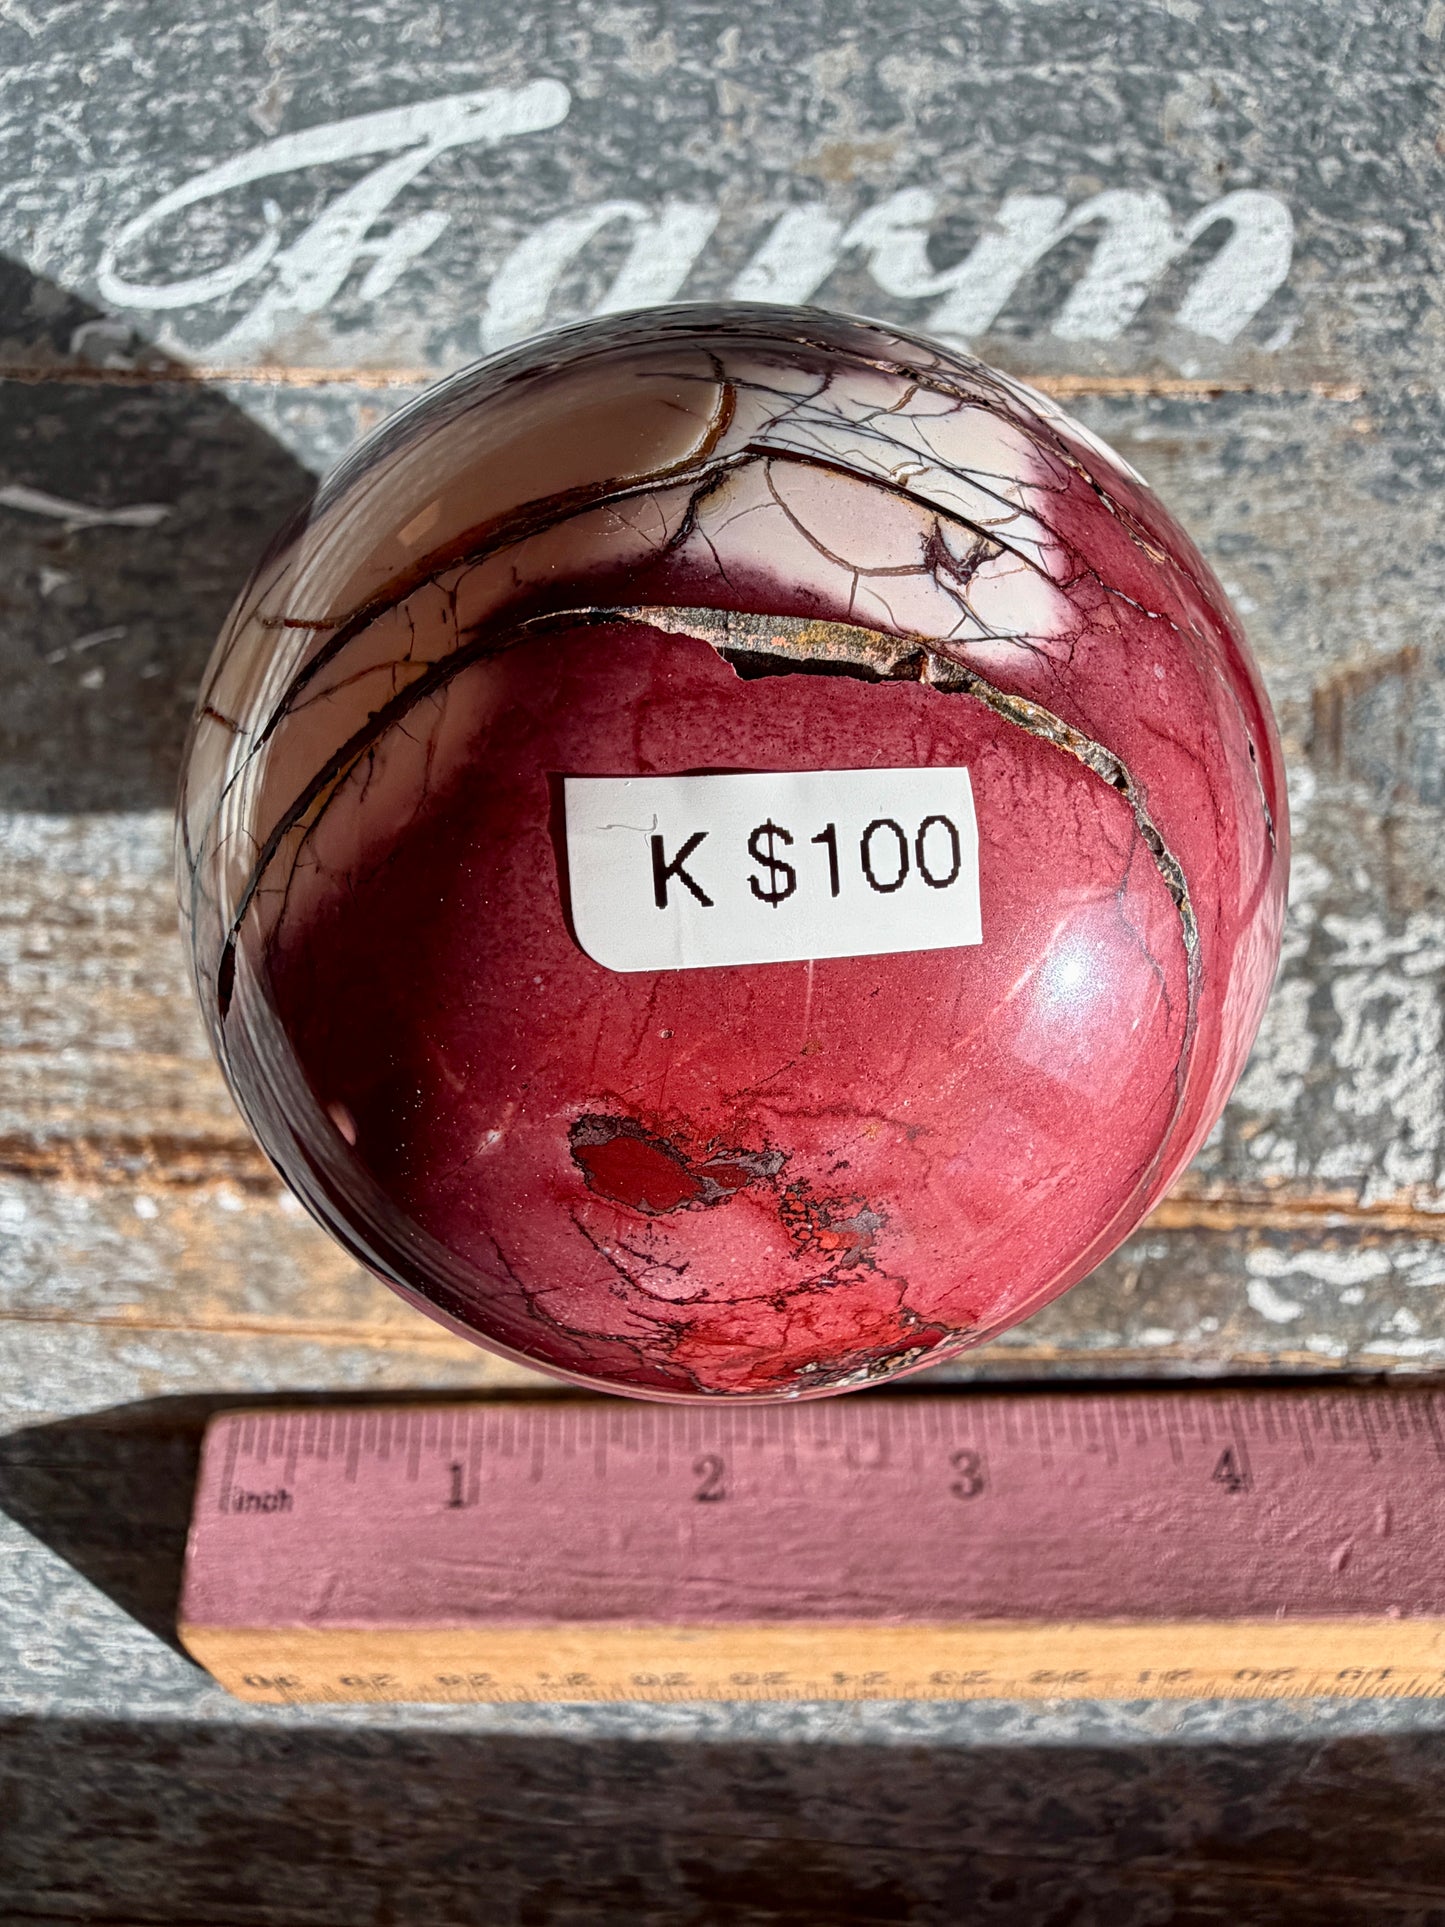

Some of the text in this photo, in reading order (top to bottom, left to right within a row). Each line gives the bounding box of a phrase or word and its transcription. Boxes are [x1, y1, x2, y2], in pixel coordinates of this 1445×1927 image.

[97, 77, 1296, 355] Farm
[650, 814, 962, 910] K $100
[233, 1484, 294, 1513] inch
[448, 1445, 1250, 1508] 1 2 3 4
